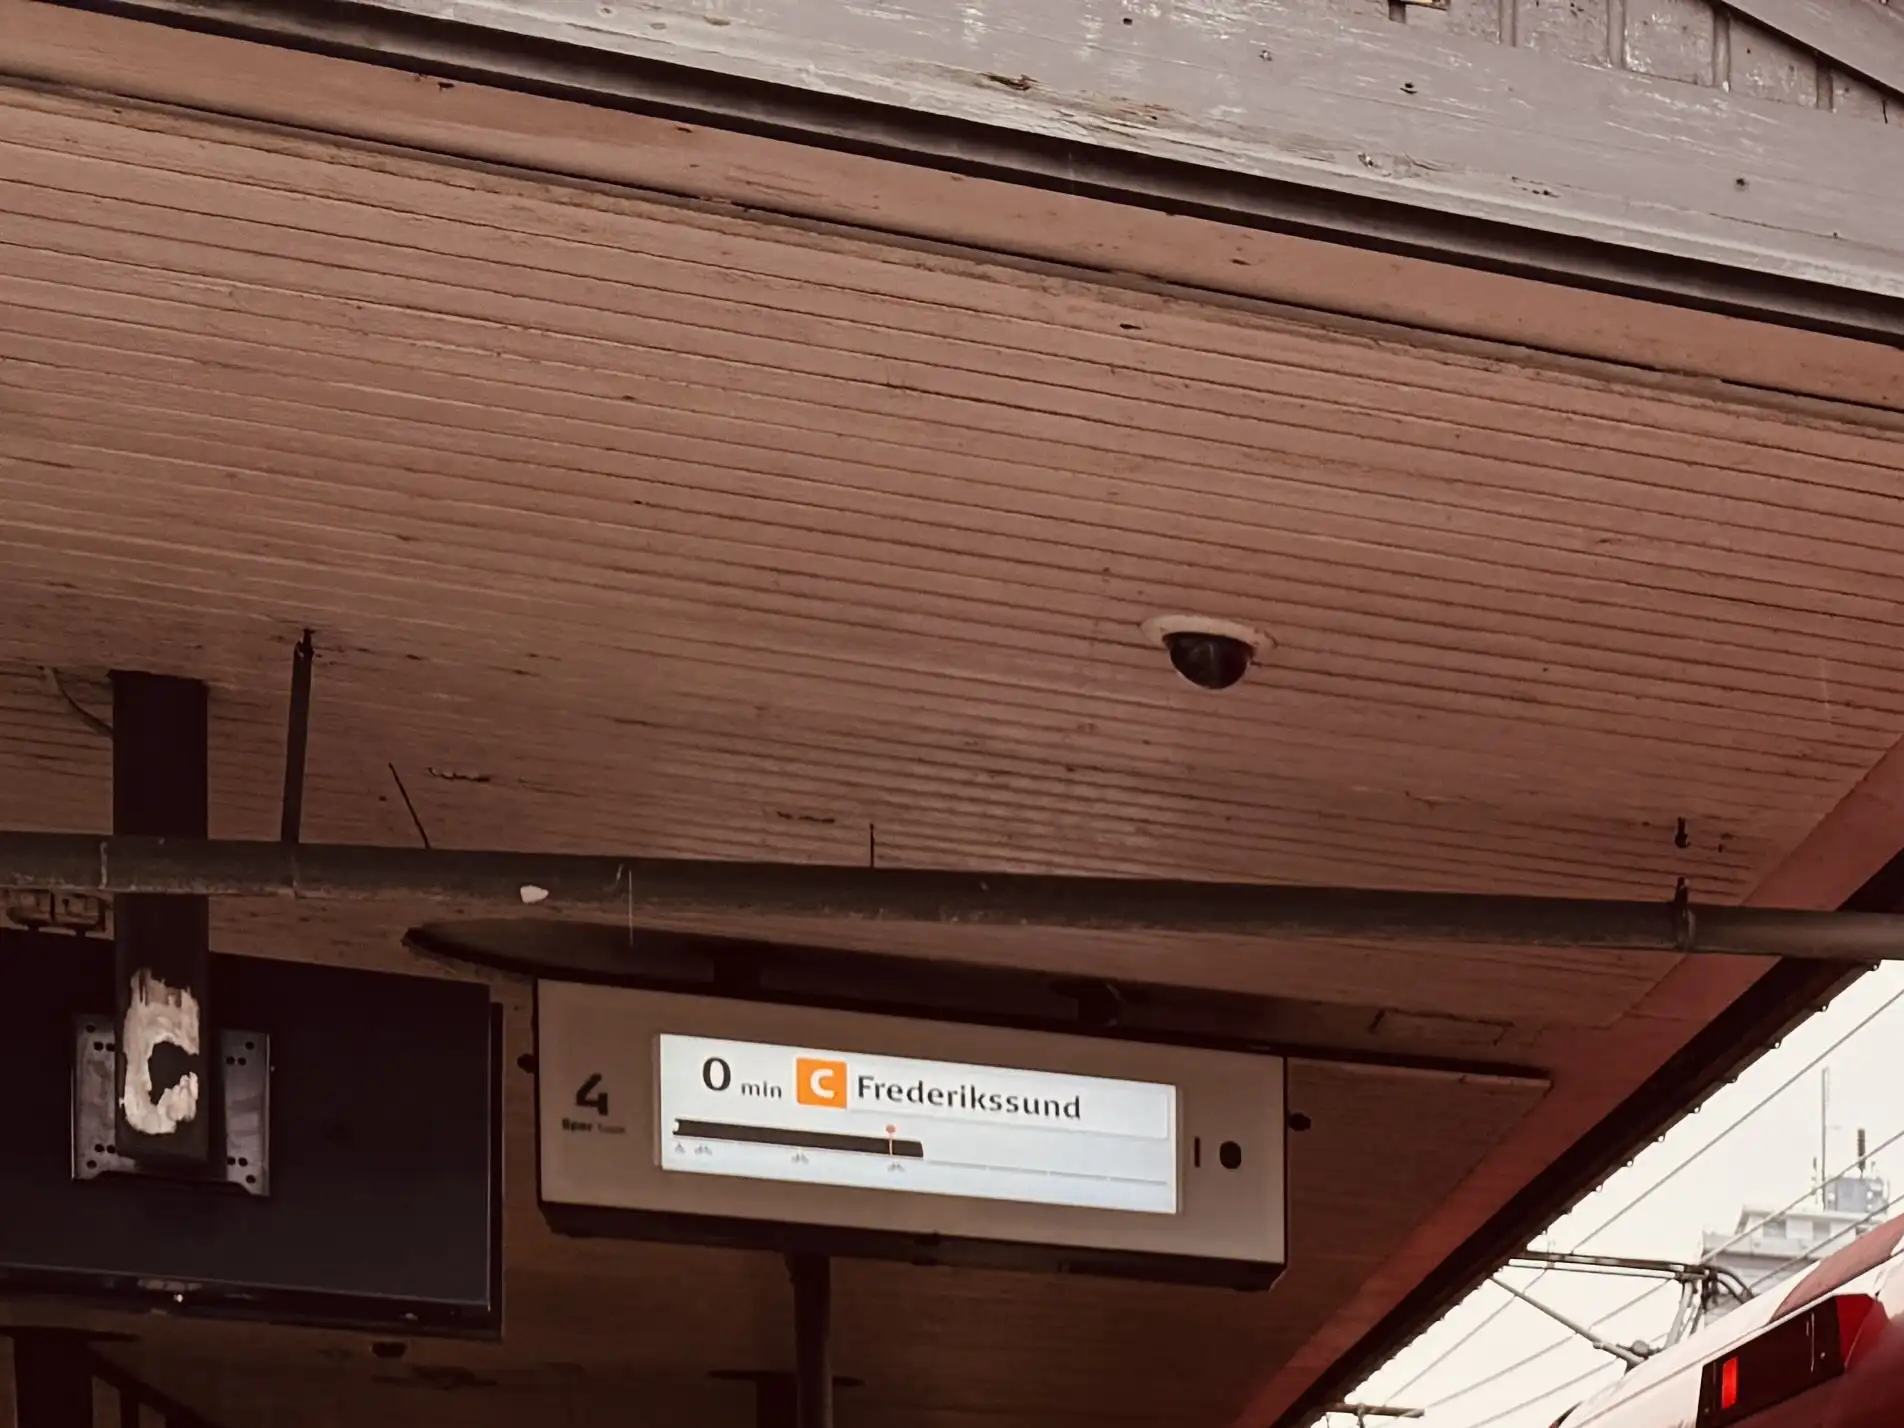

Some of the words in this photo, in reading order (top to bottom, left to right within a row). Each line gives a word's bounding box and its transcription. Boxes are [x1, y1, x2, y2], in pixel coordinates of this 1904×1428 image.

[576, 1072, 608, 1116] 4
[702, 1057, 731, 1091] 0
[741, 1080, 782, 1099] min
[810, 1068, 836, 1099] C
[858, 1075, 1081, 1121] Frederikssund
